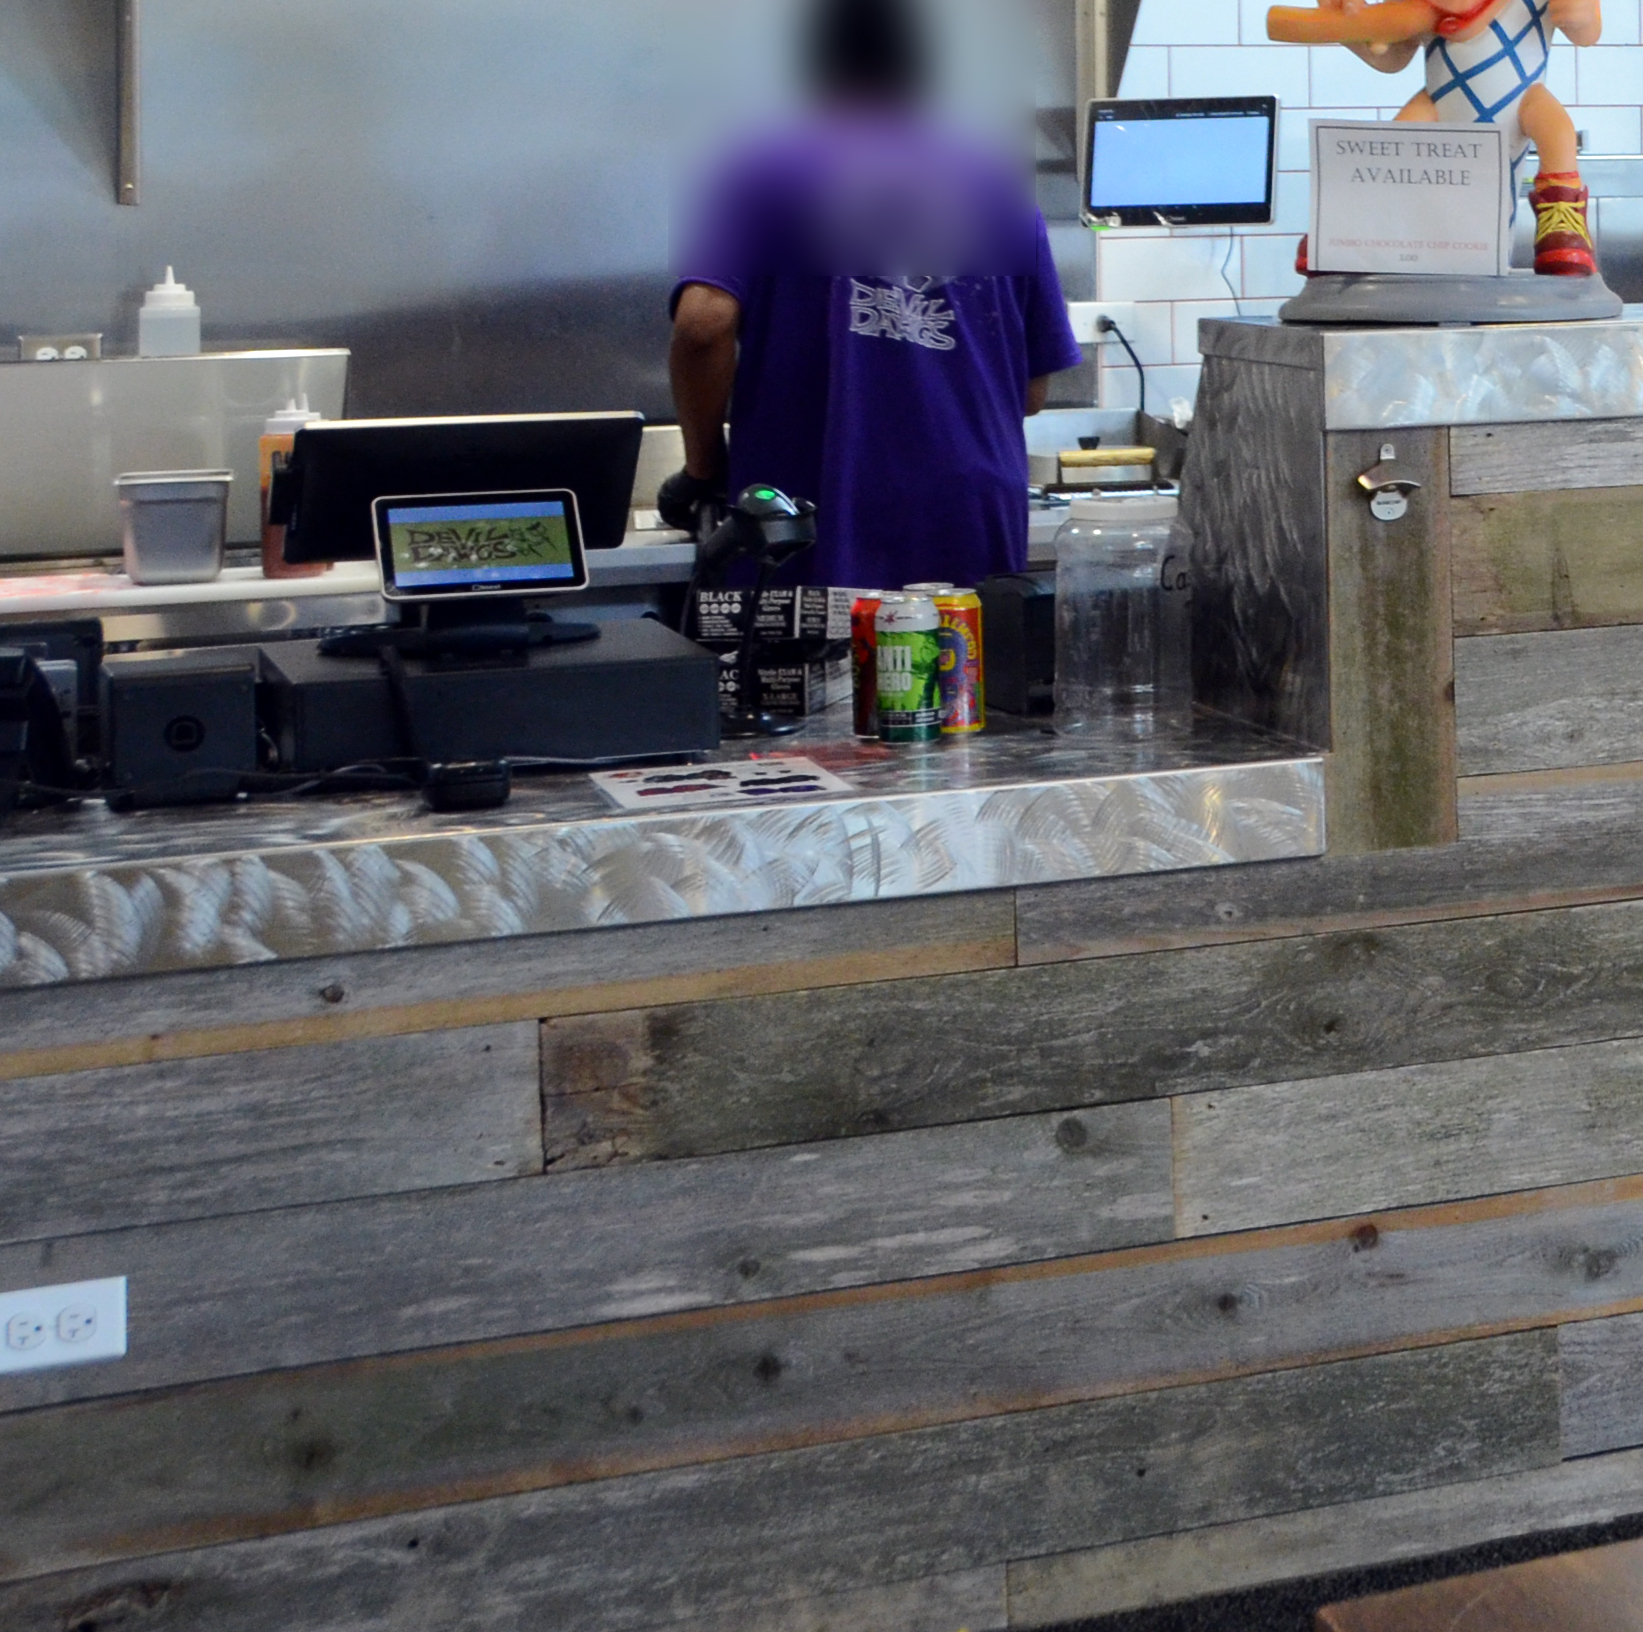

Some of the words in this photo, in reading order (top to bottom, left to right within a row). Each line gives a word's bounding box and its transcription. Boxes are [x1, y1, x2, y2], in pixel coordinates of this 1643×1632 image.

[1336, 140, 1404, 157] SWEET
[1411, 141, 1483, 159] TREAT
[1351, 167, 1472, 186] AVAILABLE
[1364, 239, 1424, 249] CHOCOLATE
[1452, 241, 1490, 251] COOKIE
[849, 277, 955, 321] DEVIL
[405, 525, 511, 547] DEVIL
[699, 590, 743, 603] BLACK
